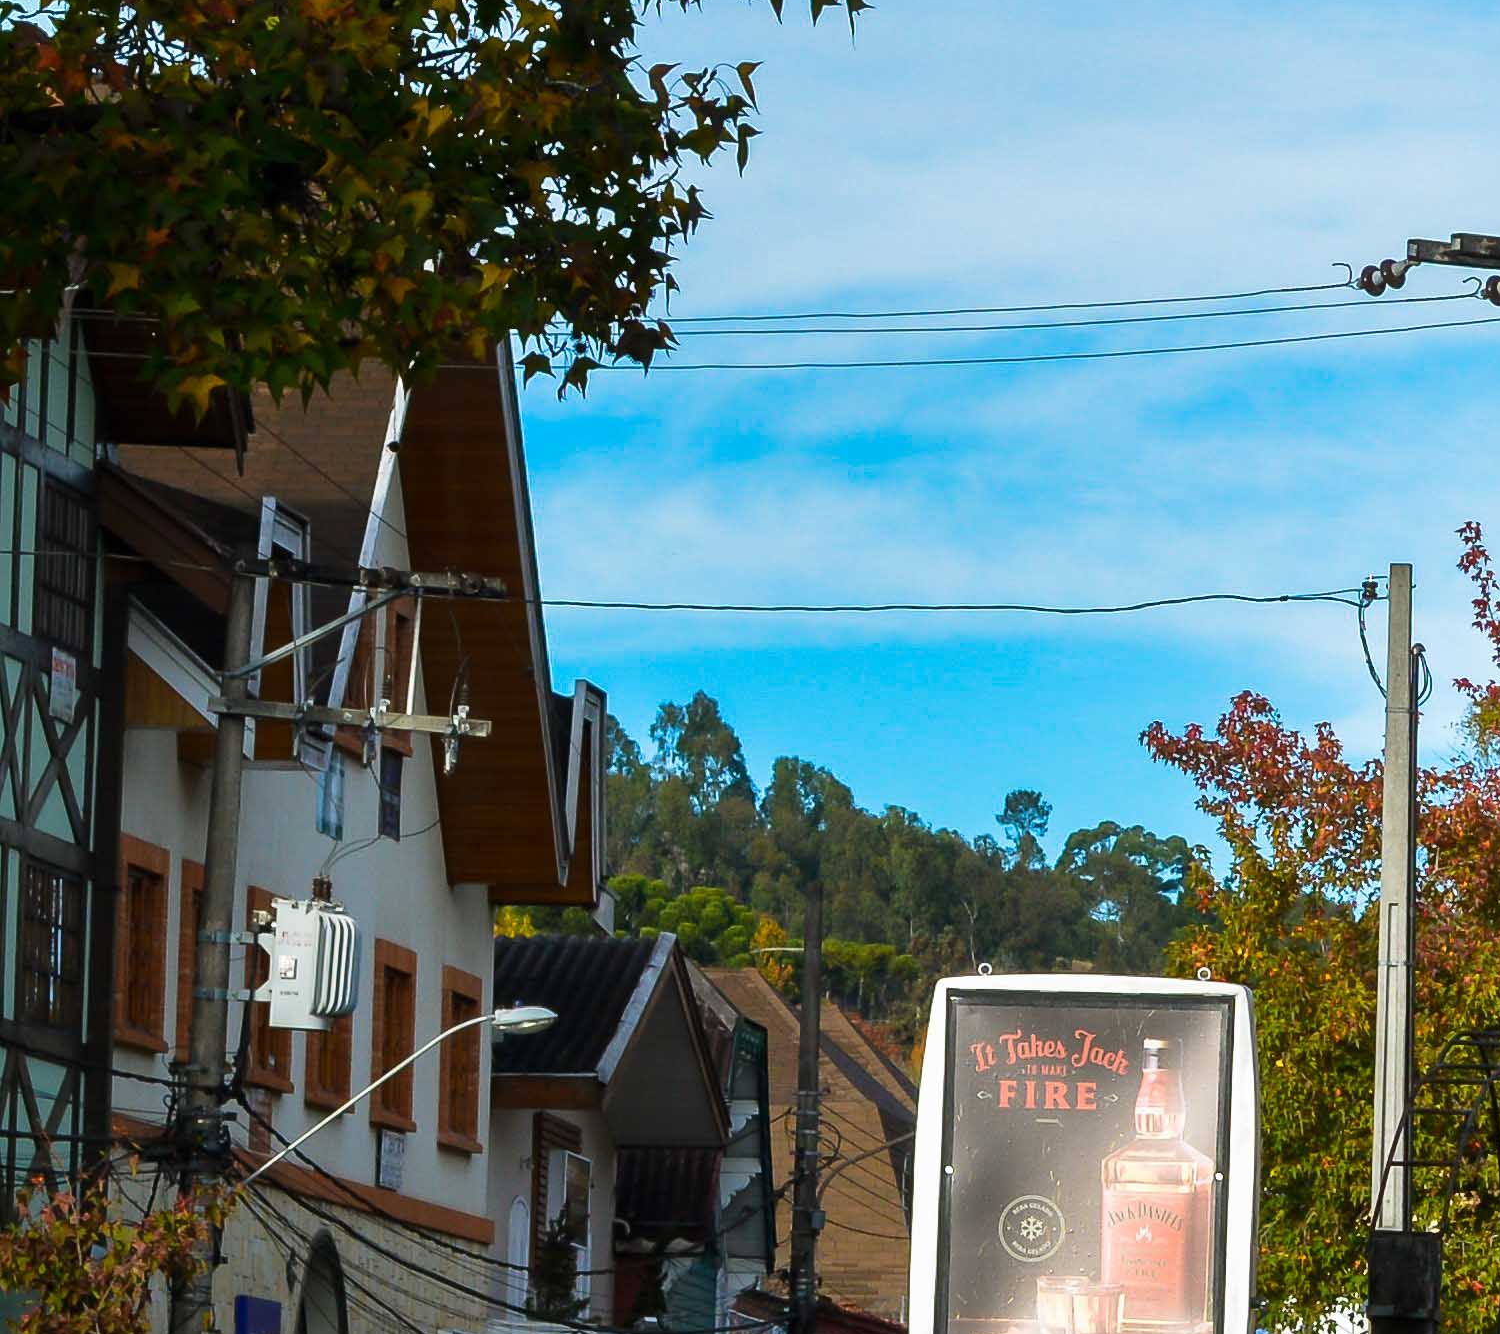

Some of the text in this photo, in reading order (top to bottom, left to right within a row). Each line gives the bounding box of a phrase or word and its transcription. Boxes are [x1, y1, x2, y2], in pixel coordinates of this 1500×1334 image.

[970, 1029, 1129, 1075] It Takes Jack
[998, 1080, 1097, 1111] FIRE
